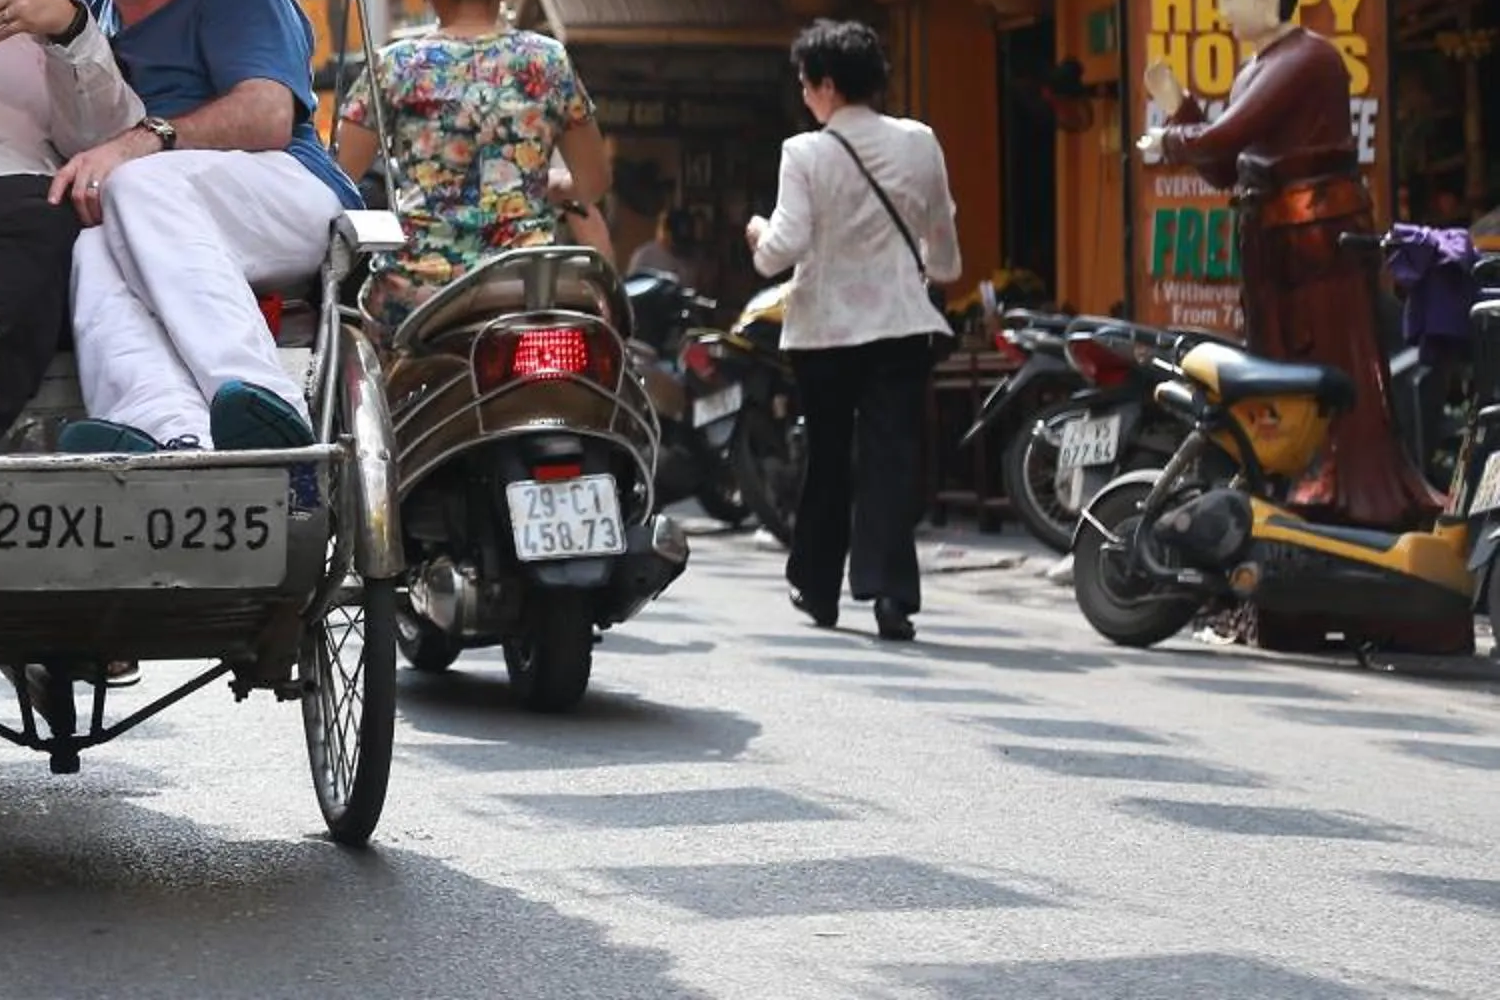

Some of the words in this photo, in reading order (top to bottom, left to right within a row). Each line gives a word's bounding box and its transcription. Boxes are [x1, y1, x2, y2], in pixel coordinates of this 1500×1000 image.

[1145, 32, 1371, 96] HOS
[1172, 303, 1217, 325] From
[524, 482, 602, 520] 29-C1
[523, 517, 618, 553] 458.73
